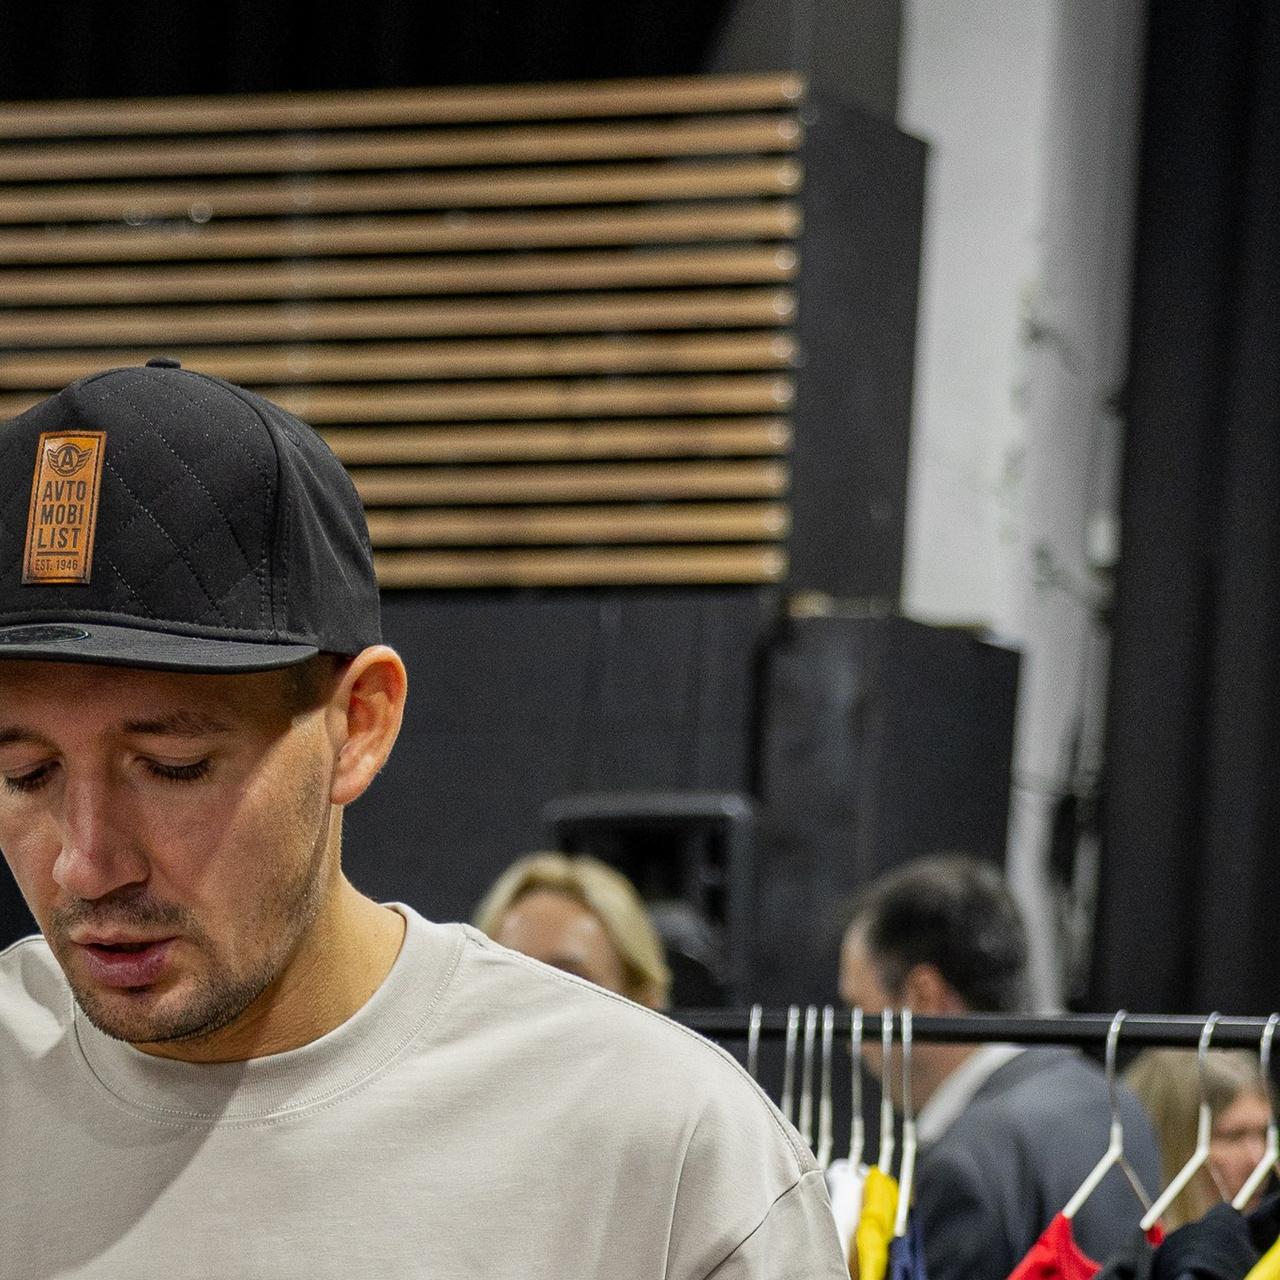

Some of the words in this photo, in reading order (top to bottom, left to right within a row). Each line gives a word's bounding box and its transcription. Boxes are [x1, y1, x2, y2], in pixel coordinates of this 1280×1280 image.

[42, 480, 87, 502] AVTO
[40, 504, 84, 525] MOBI
[37, 528, 81, 549] LIST
[35, 559, 53, 571] EST.
[56, 559, 78, 571] 1946
